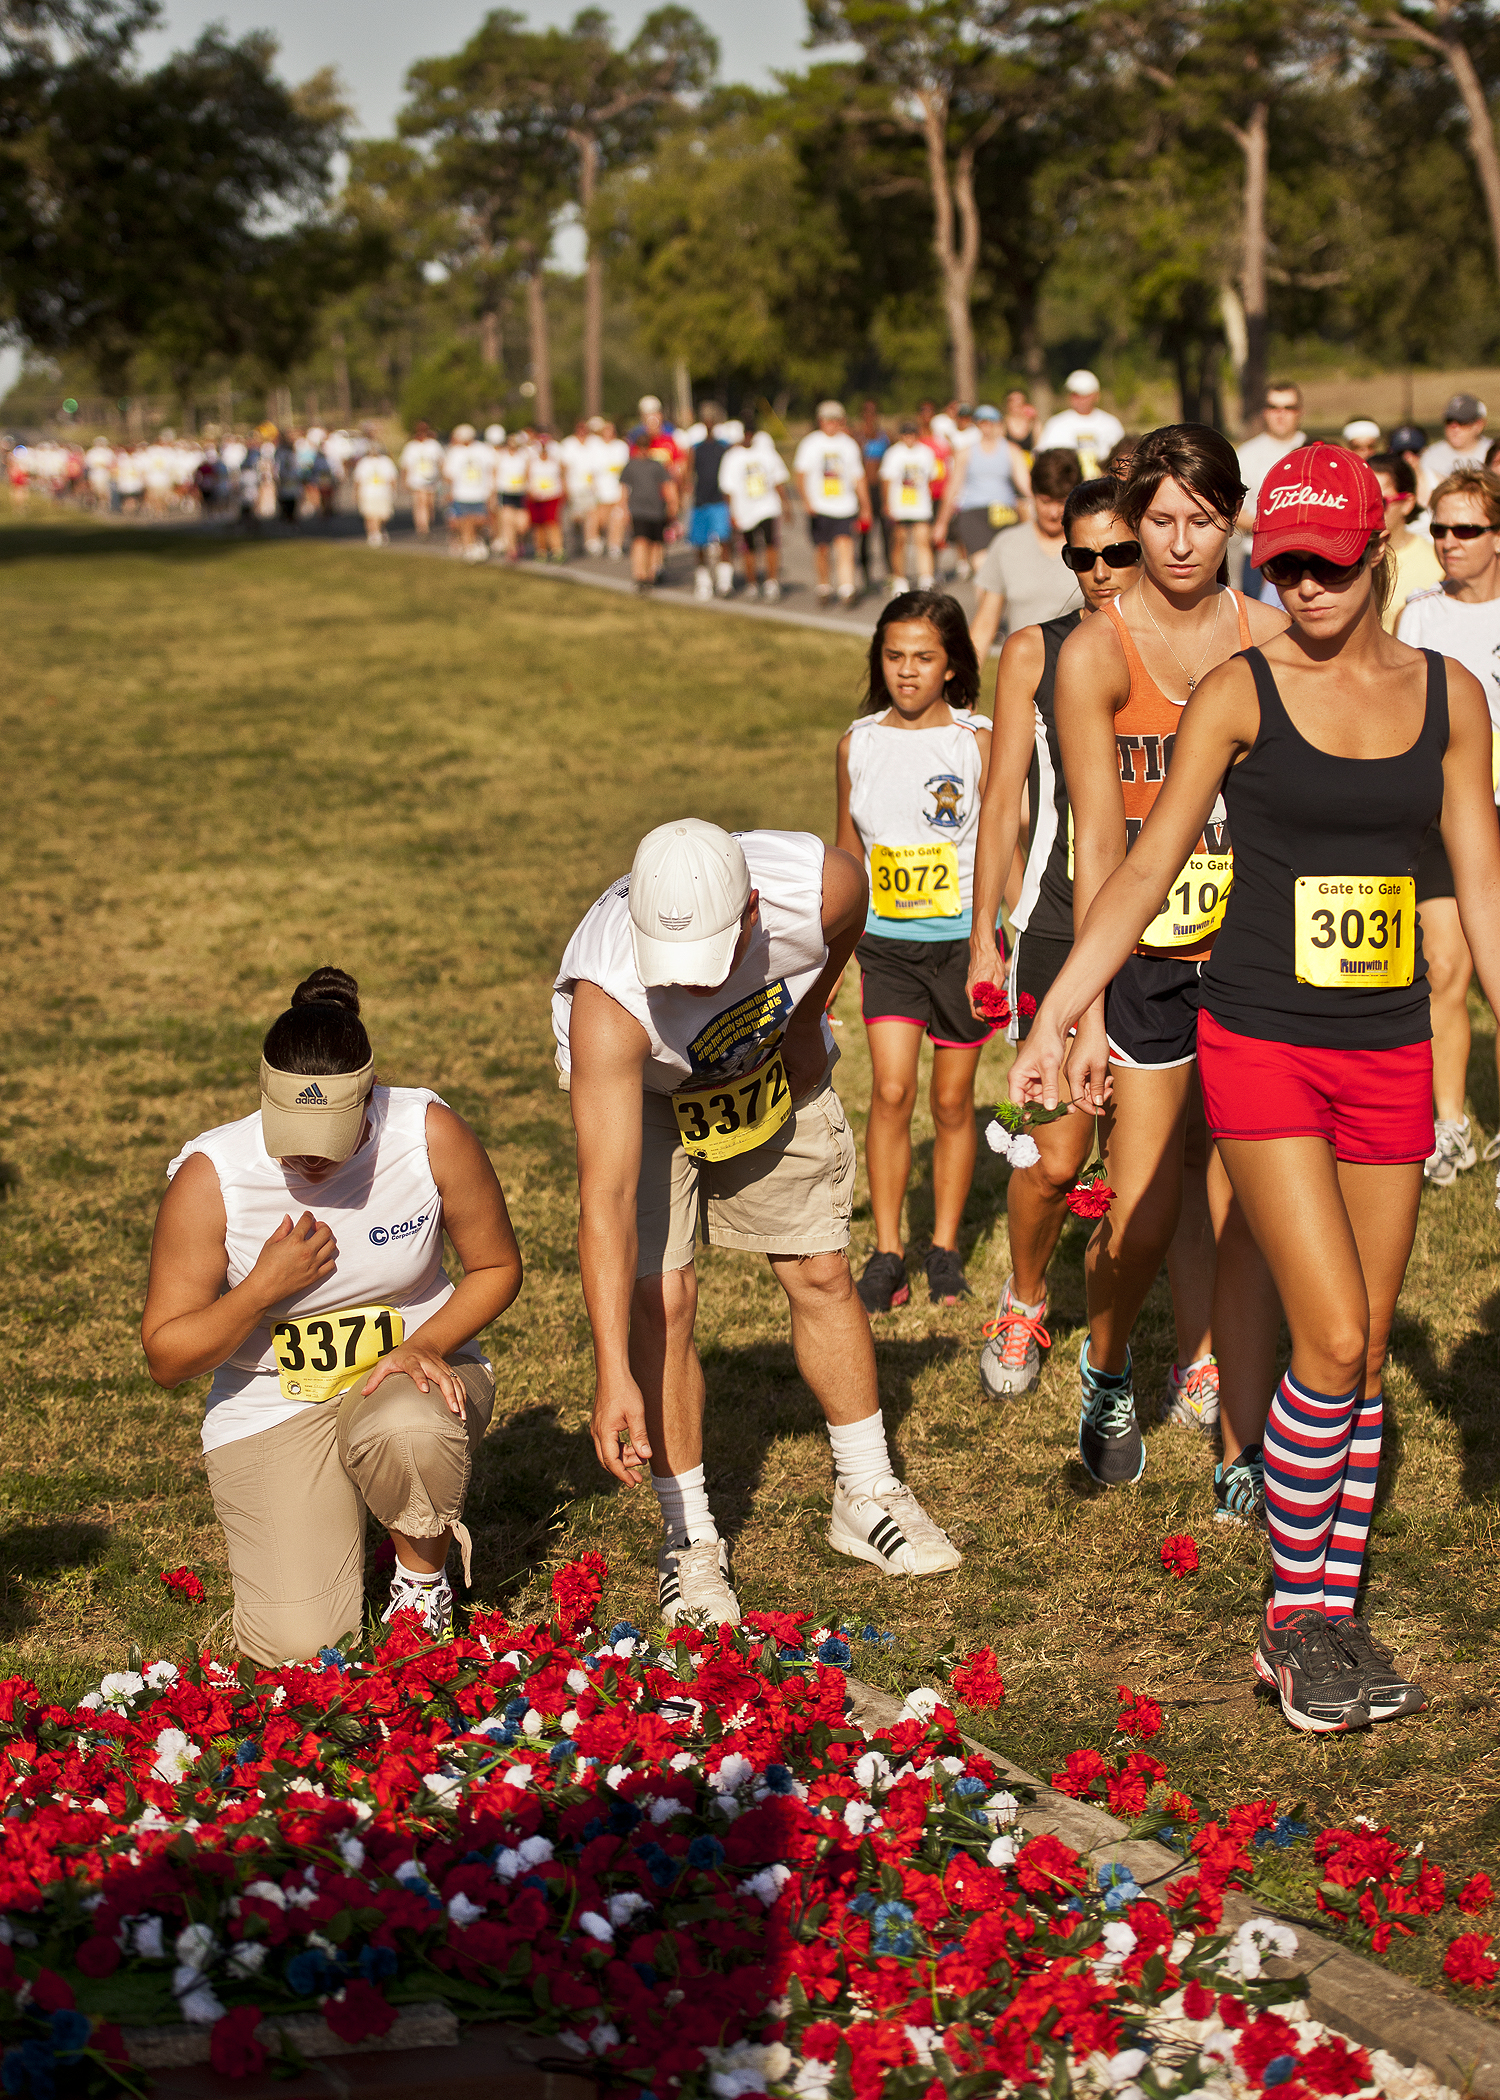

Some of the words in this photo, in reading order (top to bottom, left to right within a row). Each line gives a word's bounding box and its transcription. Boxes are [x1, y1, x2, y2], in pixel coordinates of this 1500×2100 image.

[1264, 483, 1348, 515] Titleist
[904, 849, 915, 857] to
[918, 847, 942, 856] Gate
[1190, 860, 1203, 870] to
[878, 864, 950, 892] 3072
[1318, 883, 1354, 895] Gate
[1359, 883, 1374, 895] to
[1378, 883, 1401, 895] Gate
[1311, 909, 1402, 949] 3031
[698, 1050, 705, 1061] of
[703, 1043, 713, 1057] the
[711, 1032, 722, 1048] free
[721, 1022, 736, 1037] only
[734, 1017, 744, 1028] so
[743, 1008, 760, 1023] long
[759, 1003, 770, 1014] as
[767, 999, 775, 1010] it
[773, 996, 782, 1006] is
[702, 1021, 720, 1042] nation
[718, 1012, 731, 1027] will
[730, 999, 755, 1019] remain
[754, 992, 767, 1005] the
[766, 982, 783, 998] land
[708, 1050, 720, 1063] the
[717, 1036, 734, 1054] home
[733, 1029, 741, 1041] of
[740, 1025, 753, 1037] the
[295, 1097, 328, 1105] adidas
[678, 1060, 788, 1141] 3372
[275, 1310, 399, 1372] 3371
